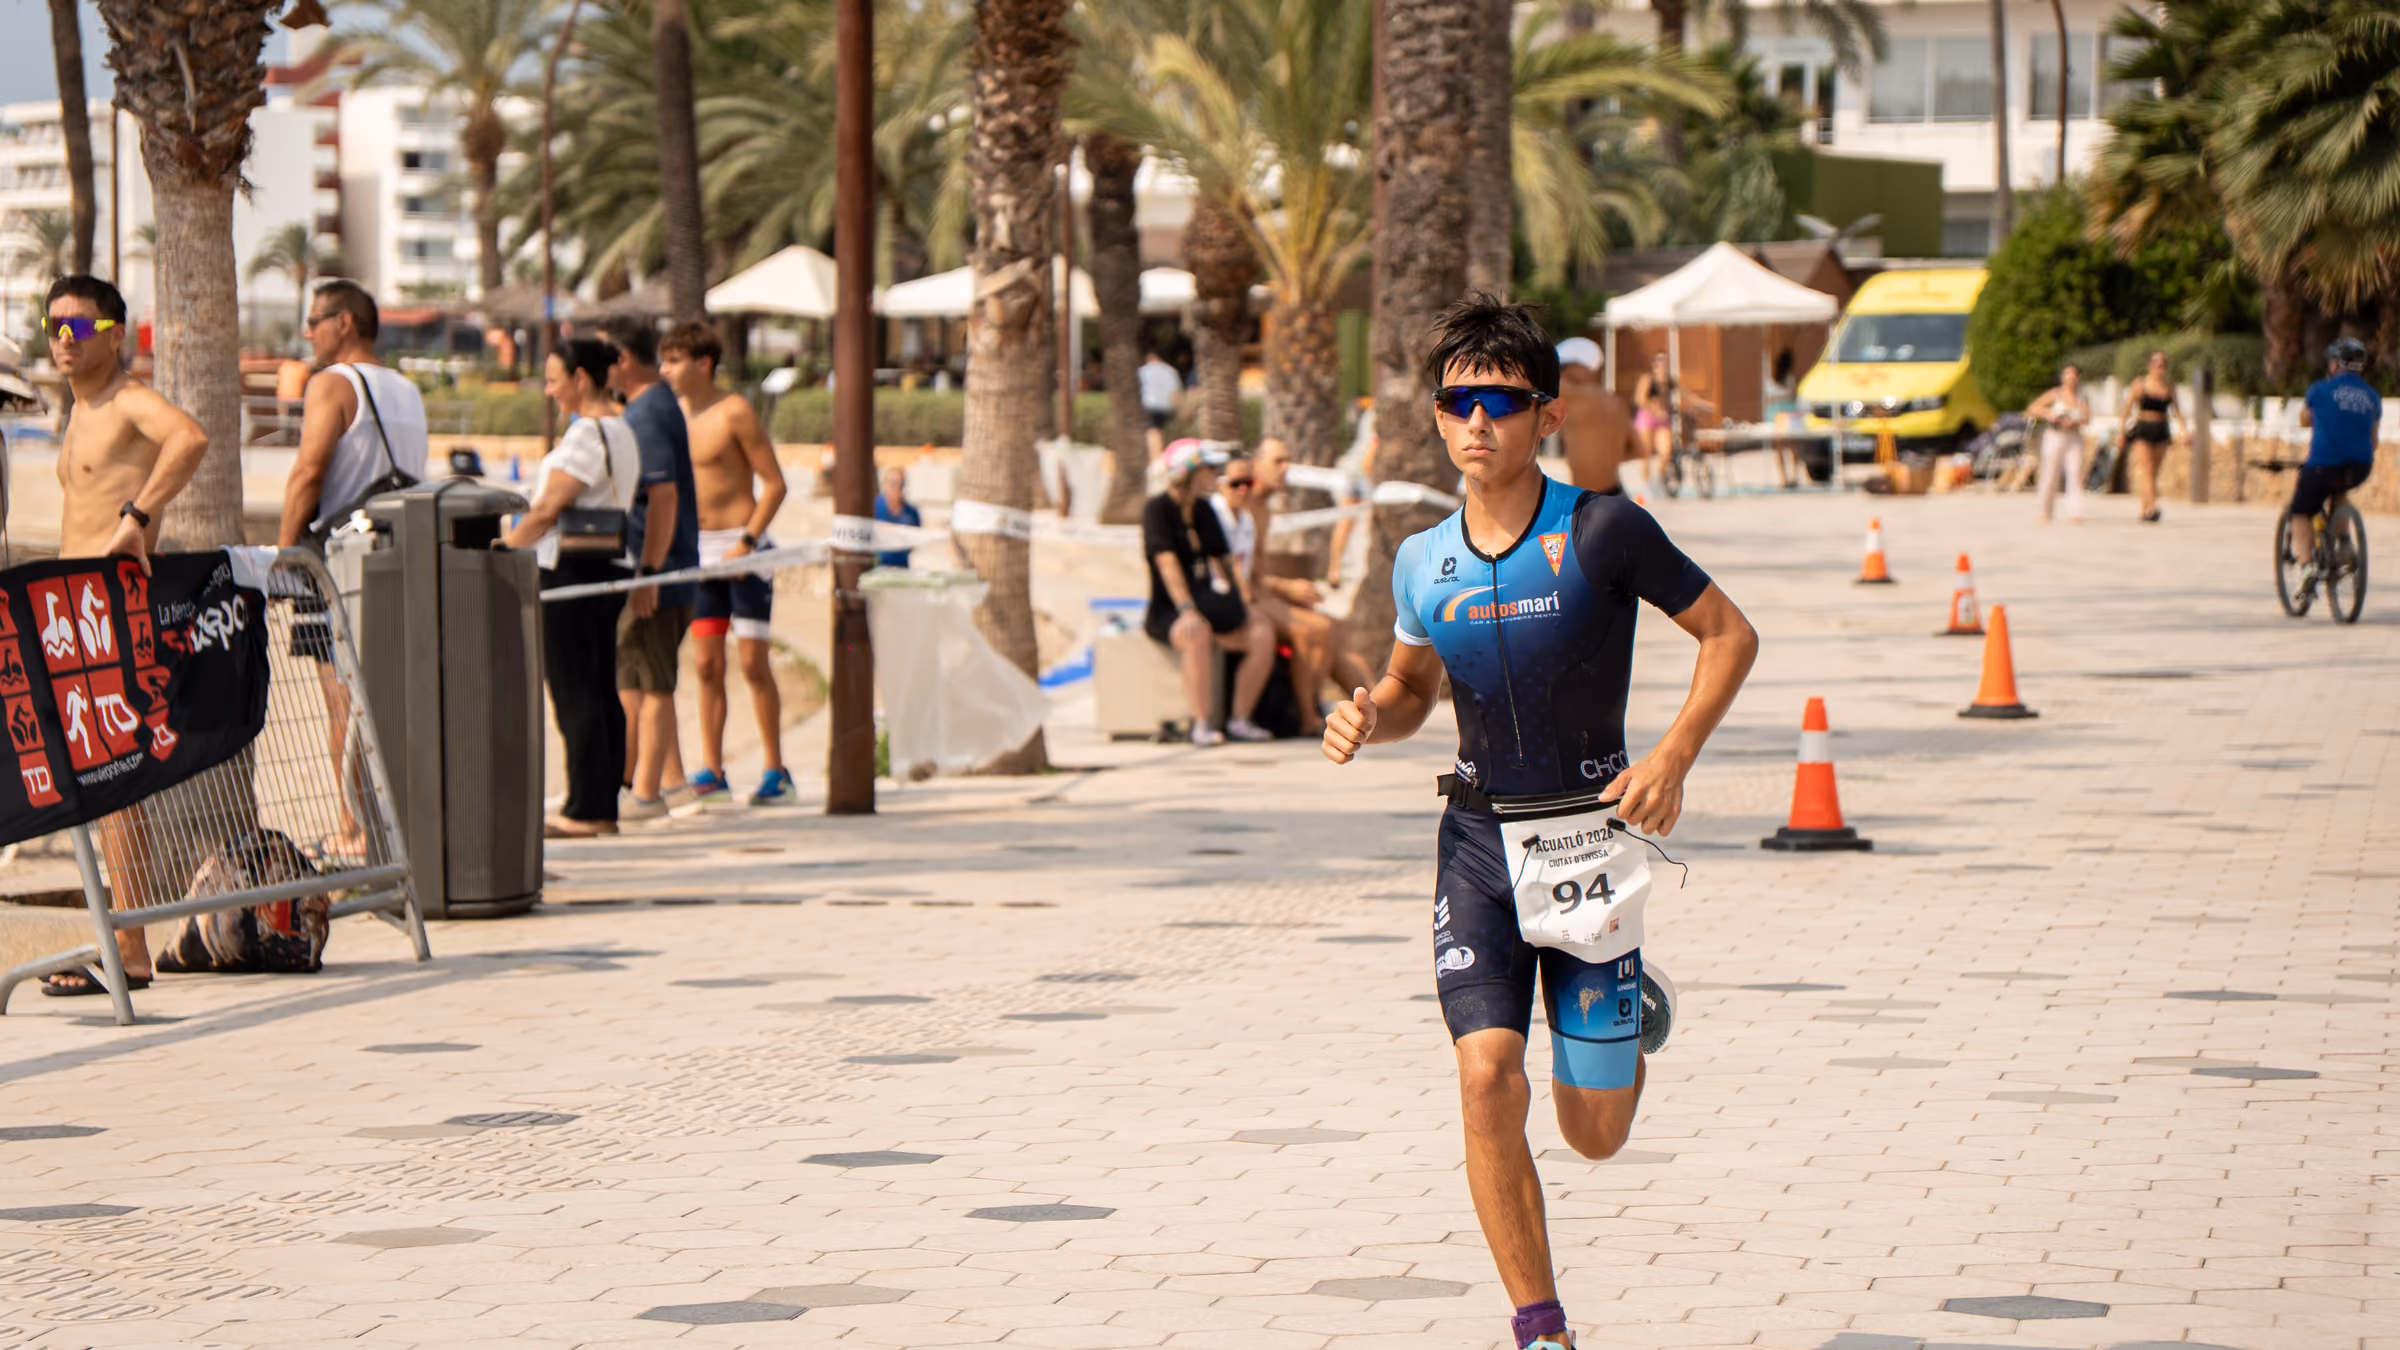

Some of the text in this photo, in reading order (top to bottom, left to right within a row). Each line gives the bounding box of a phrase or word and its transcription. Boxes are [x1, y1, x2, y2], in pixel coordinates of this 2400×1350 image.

[1468, 590, 1560, 619] autosmarí
[95, 693, 138, 736] TD
[22, 766, 51, 795] TD
[1536, 831, 1583, 854] ACUATLÓ
[1549, 856, 1573, 868] CIUTAT
[1551, 872, 1616, 915] 94
